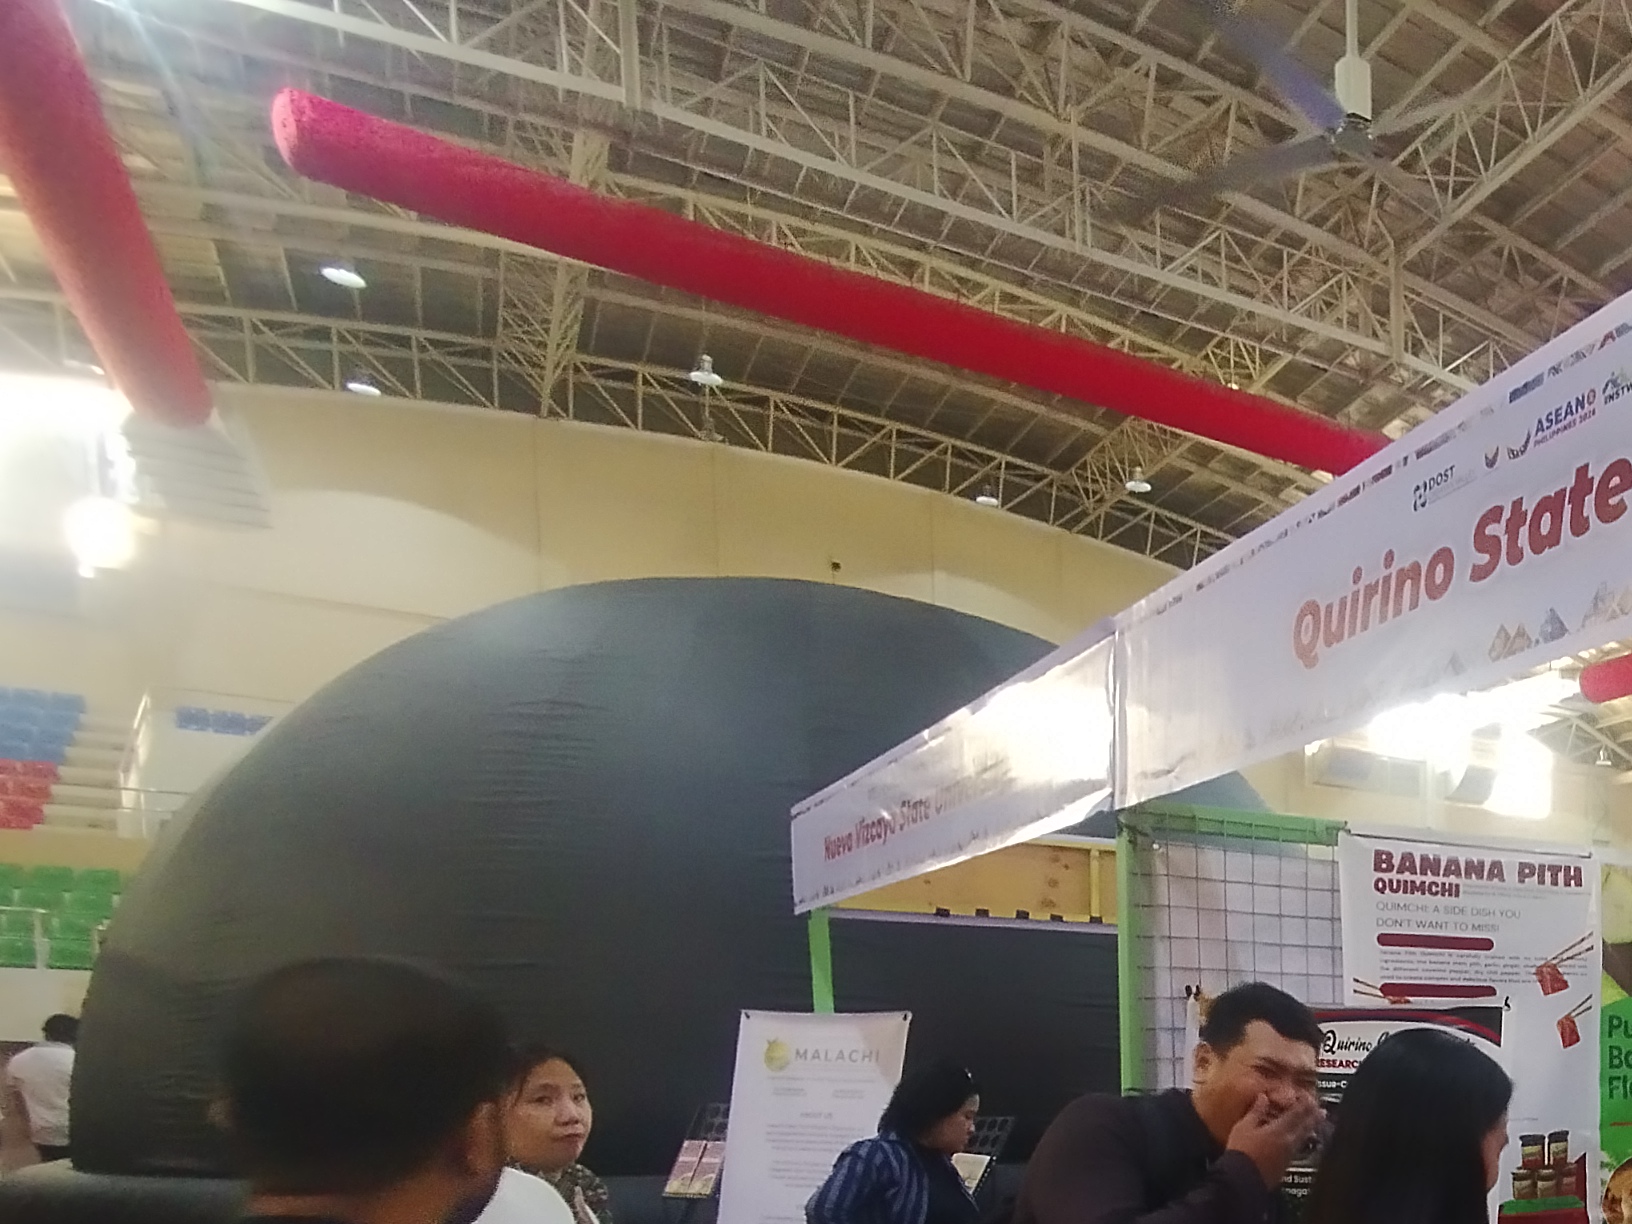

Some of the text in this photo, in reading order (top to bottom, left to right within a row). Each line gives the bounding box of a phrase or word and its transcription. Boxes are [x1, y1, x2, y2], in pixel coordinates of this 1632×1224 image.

[1534, 396, 1585, 437] ASEAN
[1534, 419, 1577, 447] PHILIPPINES
[1429, 465, 1455, 491] DOST
[1290, 543, 1455, 668] Quirino
[1470, 458, 1632, 584] State
[824, 831, 853, 862] Nueva
[855, 813, 897, 848] Vizcaya
[1373, 848, 1583, 888] BANANA PITH
[1373, 877, 1461, 898] QUIMCHI
[1416, 918, 1450, 931] WANT
[1453, 920, 1469, 931] TO
[1432, 904, 1441, 914] A
[1443, 904, 1468, 916] SIDE
[1470, 906, 1496, 918] DISH
[1499, 907, 1521, 919] YOU
[1323, 1029, 1373, 1055] Quirino
[794, 1048, 880, 1063] MALACHI
[1316, 1059, 1361, 1069] ESEARC
[1318, 1080, 1348, 1089] ssue-C
